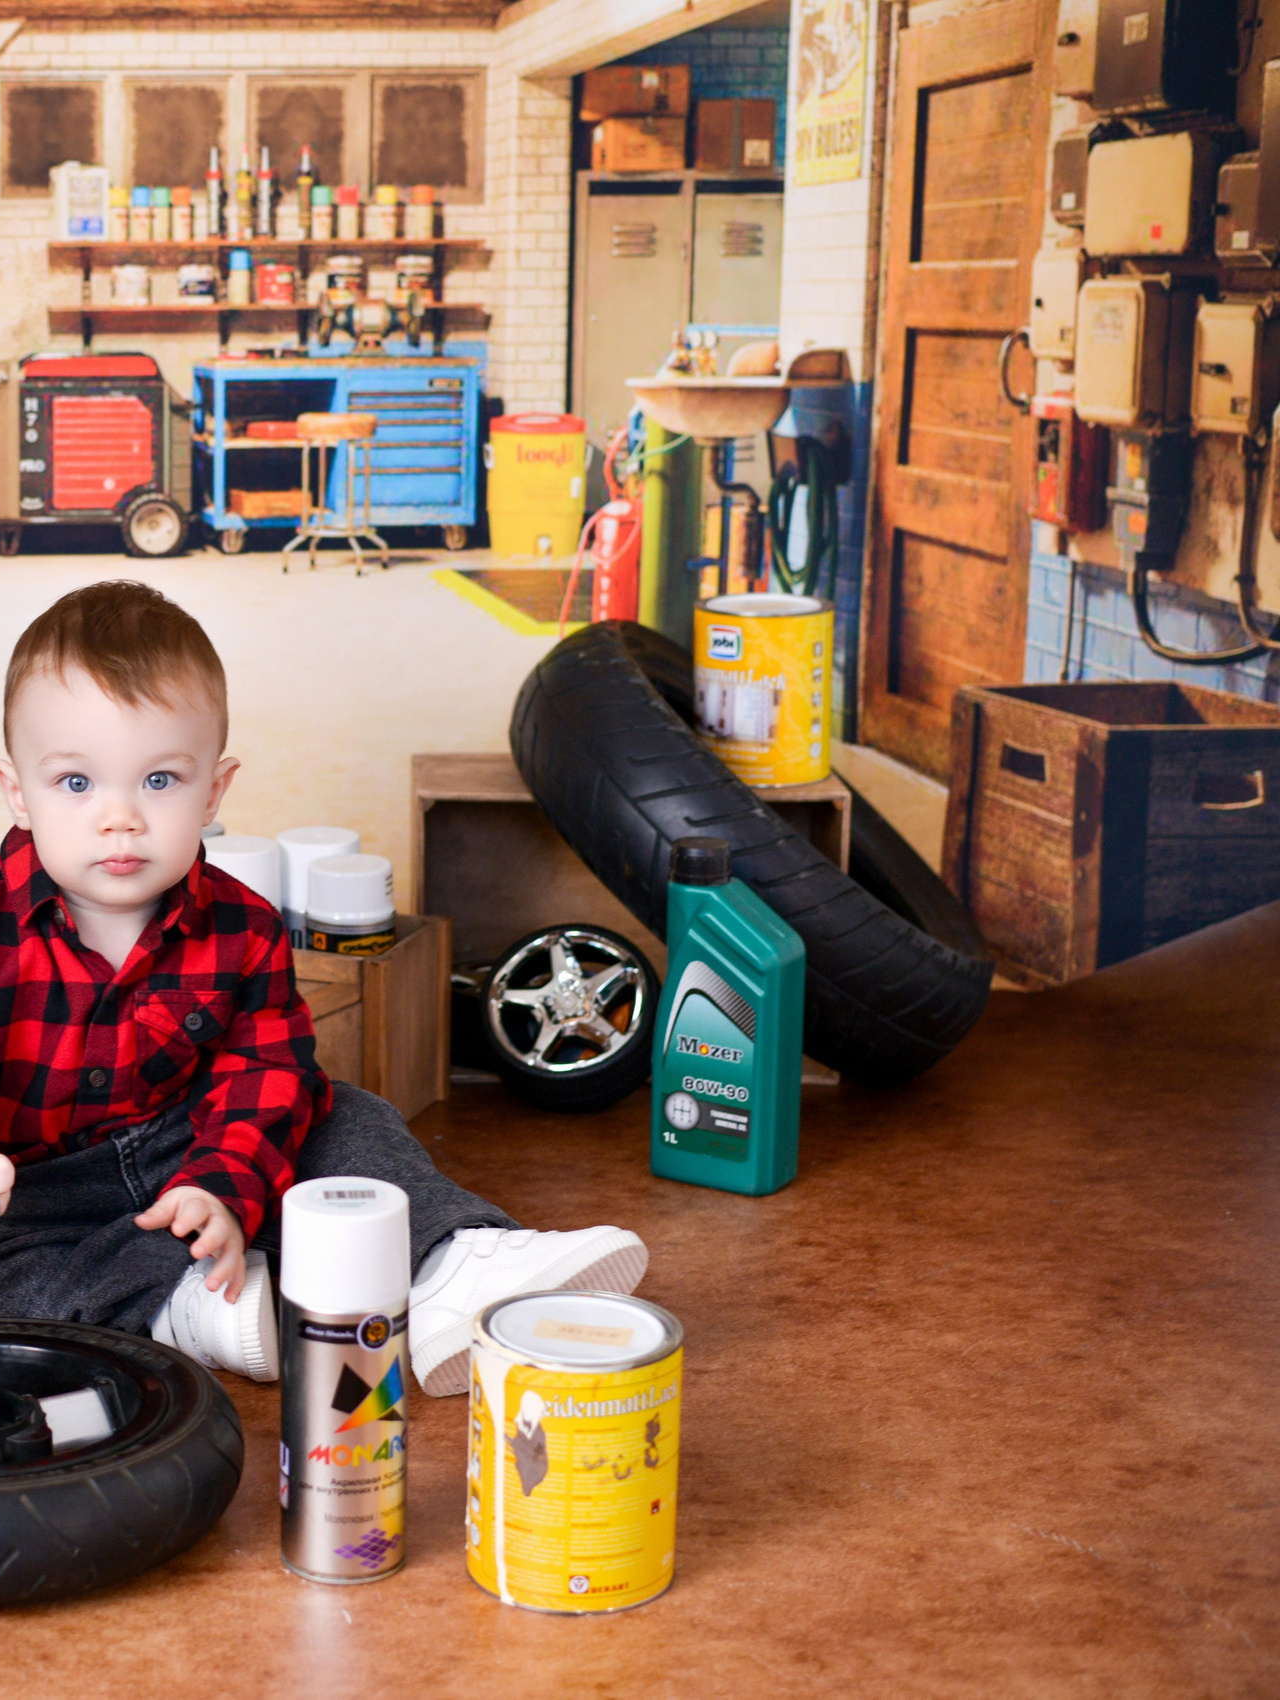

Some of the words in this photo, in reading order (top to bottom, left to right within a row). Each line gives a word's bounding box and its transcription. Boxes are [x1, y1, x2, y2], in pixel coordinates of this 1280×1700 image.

[677, 1034, 743, 1062] Mozer
[682, 1076, 749, 1102] 80W-90
[663, 1131, 678, 1145] 1L
[542, 1379, 678, 1418] eidenmattLack
